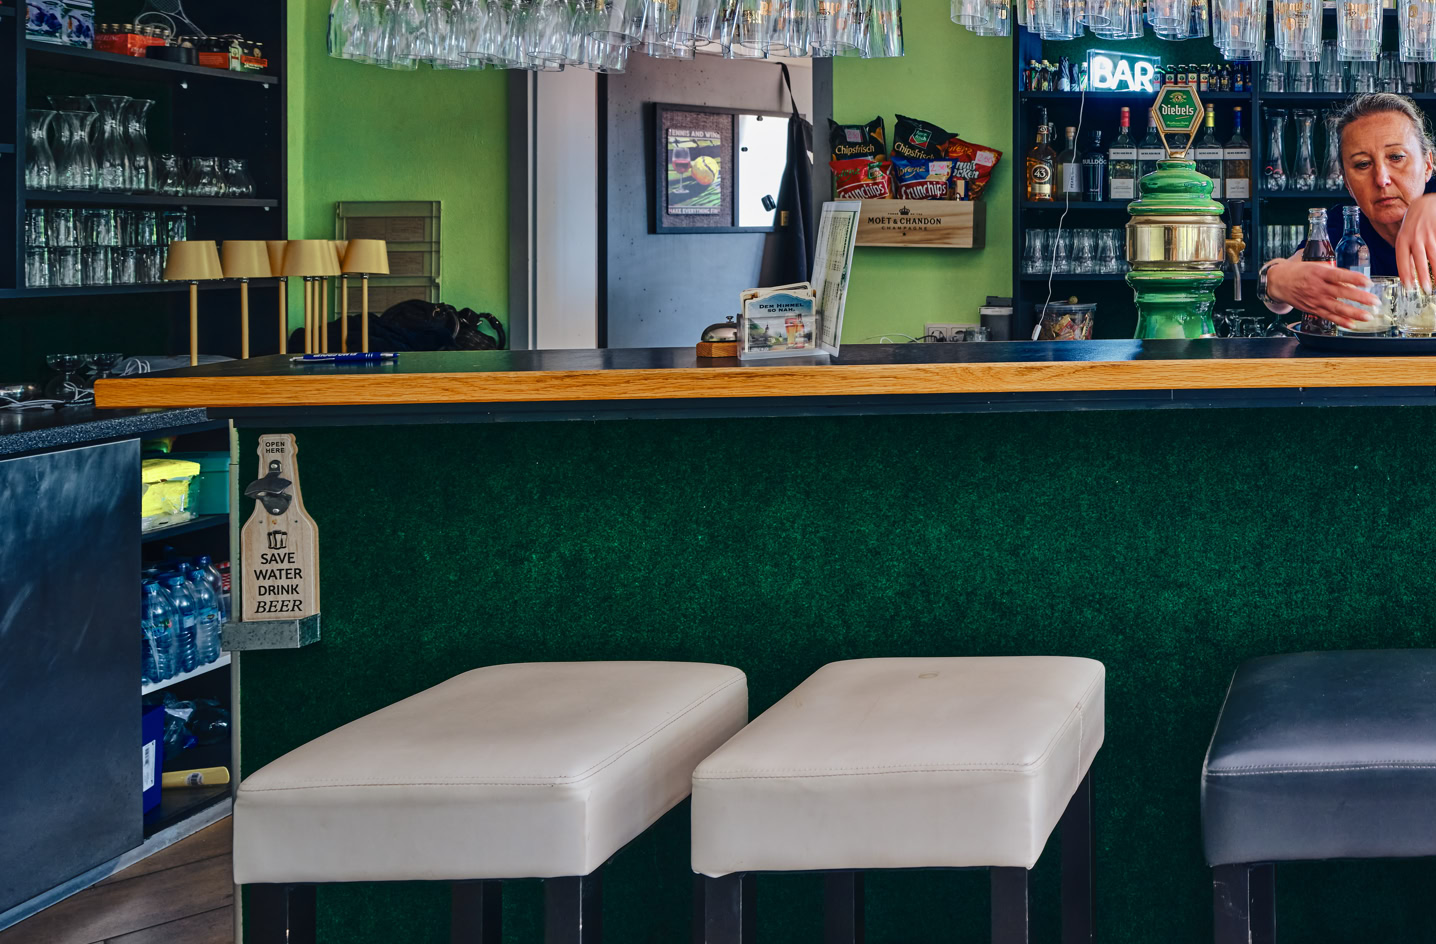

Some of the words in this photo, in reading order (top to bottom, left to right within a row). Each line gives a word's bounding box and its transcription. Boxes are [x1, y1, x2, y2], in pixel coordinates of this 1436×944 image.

[1092, 55, 1155, 92] BAR
[668, 128, 690, 137] TENNIS
[835, 144, 875, 156] Chipsfrisch
[1033, 167, 1046, 178] 43
[839, 181, 885, 199] Crunchips
[900, 181, 947, 200] Crunchips
[867, 216, 892, 224] MOËT
[899, 217, 942, 225] CHANDON
[260, 552, 296, 565] SAVE
[253, 567, 303, 581] WATER
[258, 584, 300, 596] DRINK
[254, 599, 303, 614] BEER
